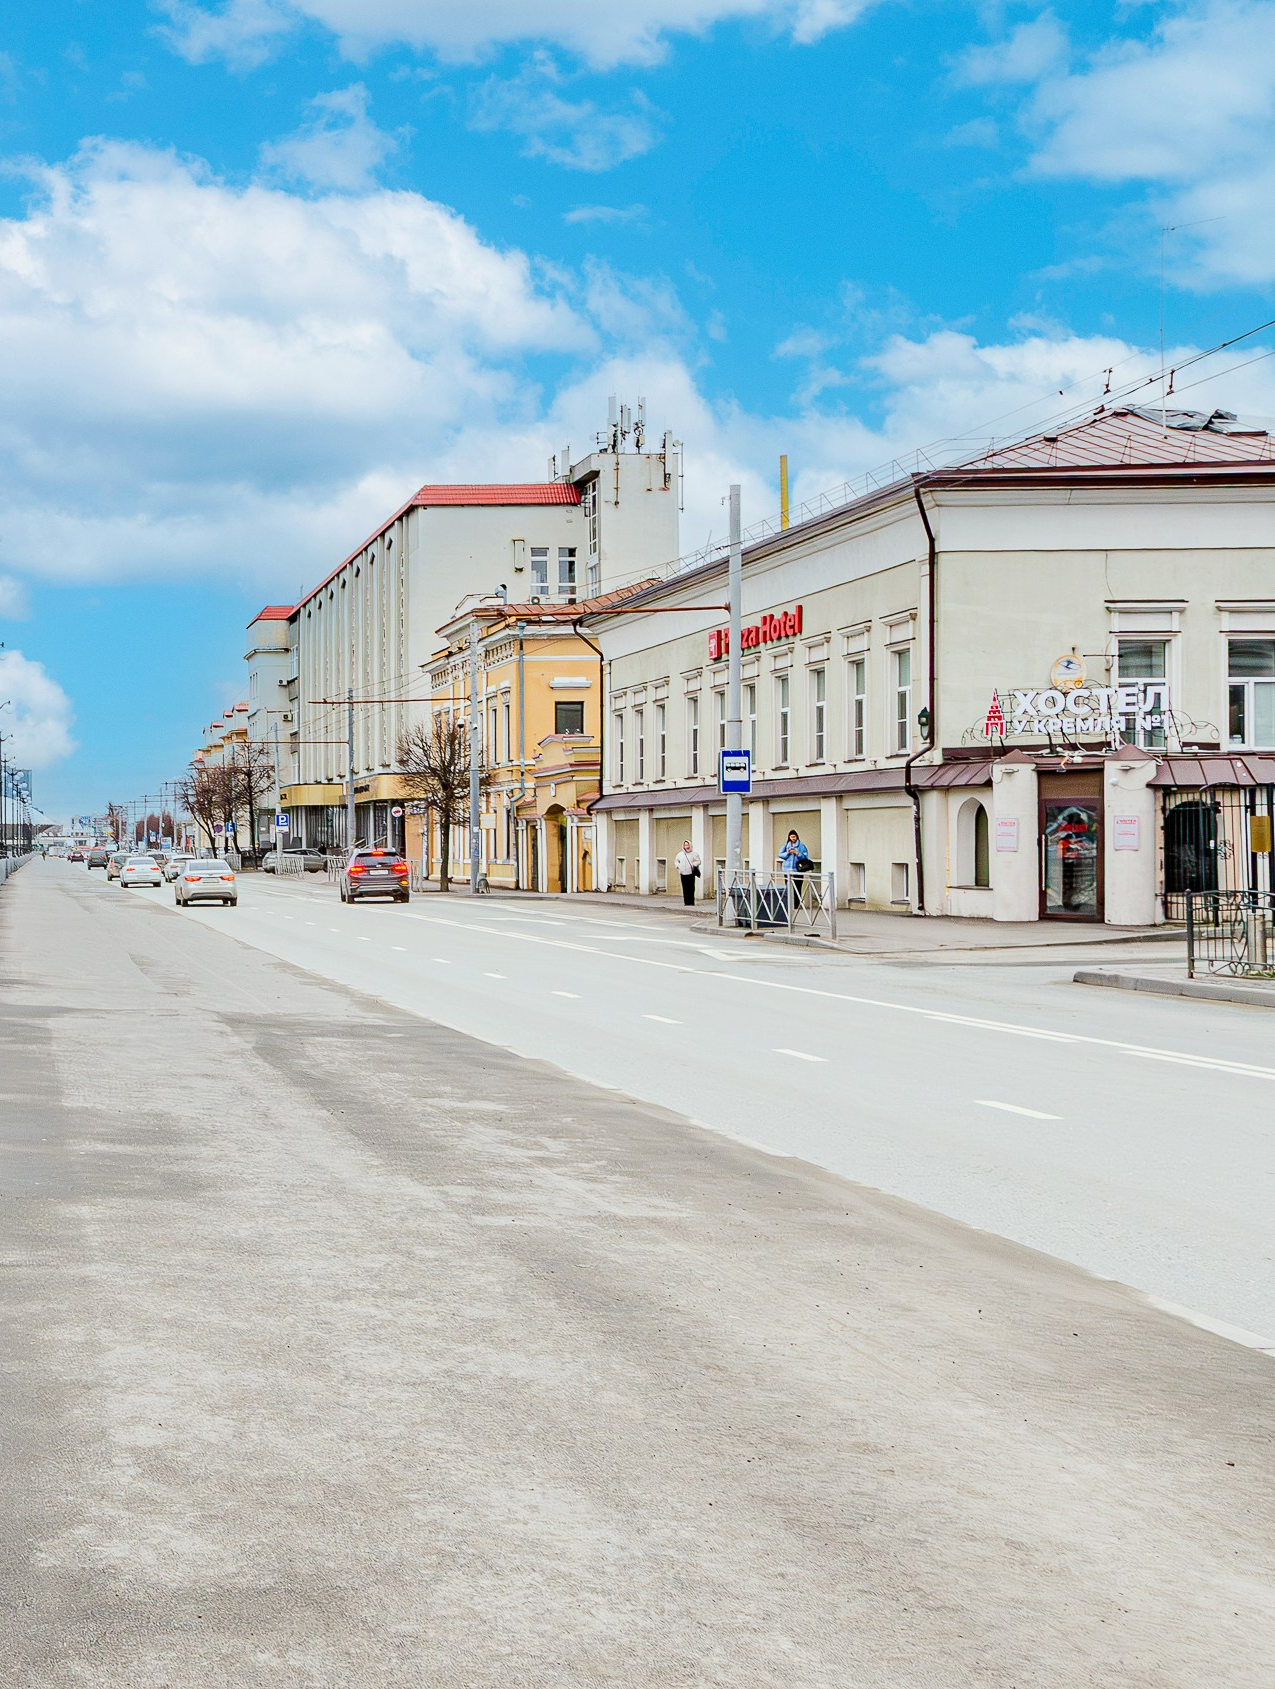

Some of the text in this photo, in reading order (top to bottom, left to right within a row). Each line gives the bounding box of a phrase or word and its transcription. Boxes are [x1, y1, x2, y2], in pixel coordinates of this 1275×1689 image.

[723, 605, 803, 655] Pza Hotel
[1013, 686, 1169, 716] ХОСТЕЛ
[1034, 717, 1125, 735] КРЕМЛЯ
